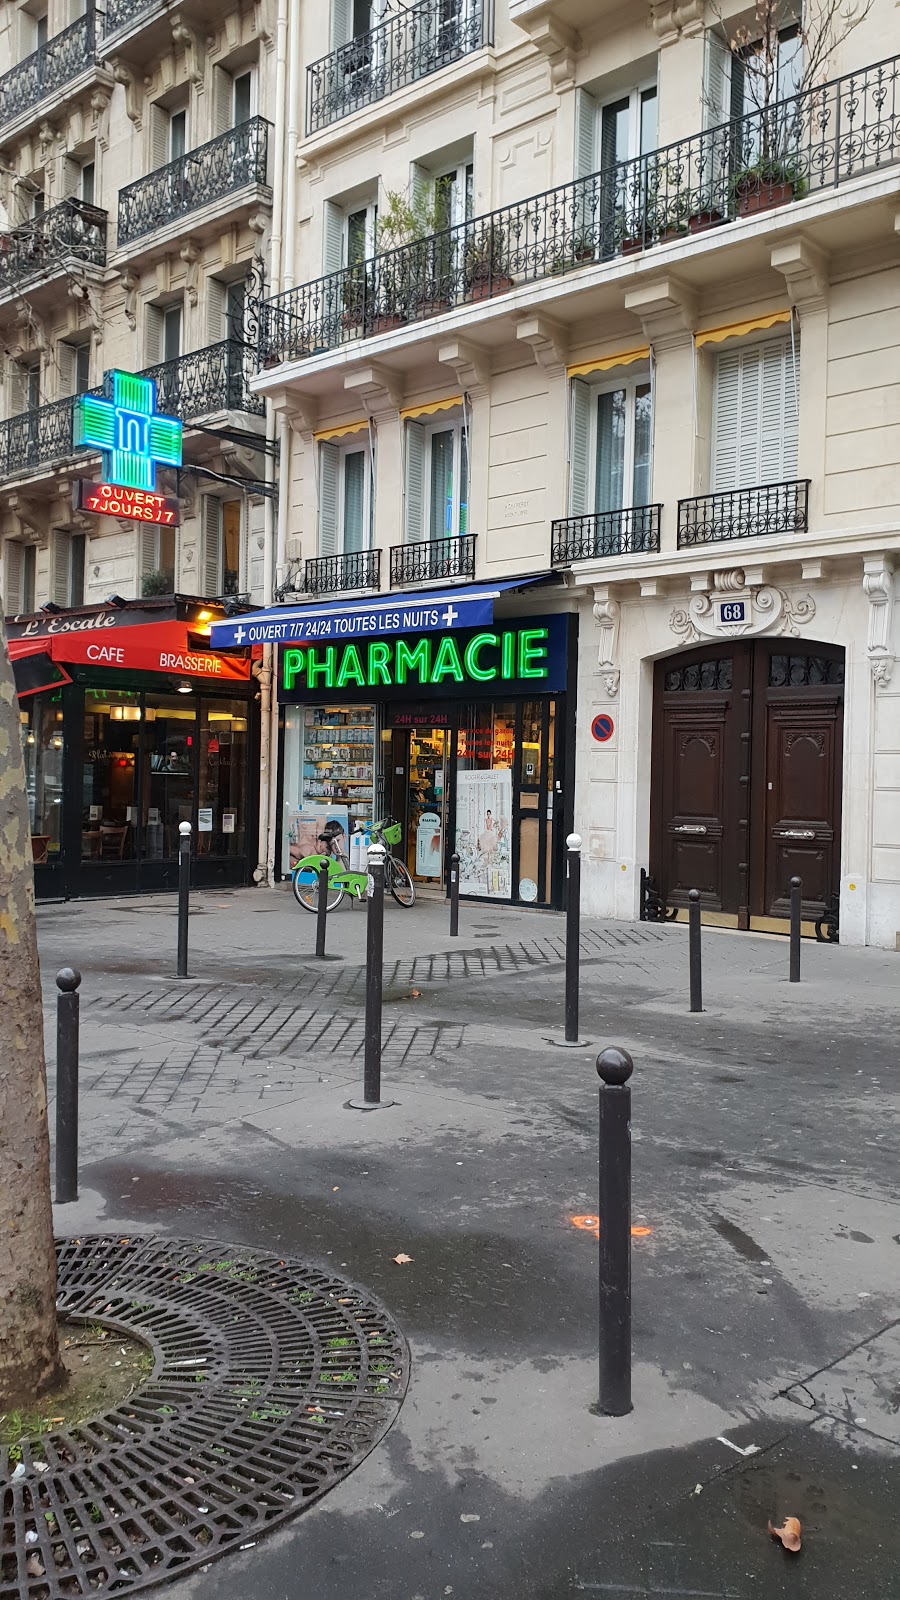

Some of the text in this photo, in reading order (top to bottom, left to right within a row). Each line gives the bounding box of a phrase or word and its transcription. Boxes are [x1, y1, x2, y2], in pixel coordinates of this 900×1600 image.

[101, 485, 164, 507] OUVERT
[724, 605, 741, 620] 68
[21, 611, 116, 637] L'Escale
[248, 610, 439, 641] OUVERT 7/7 24/24 TOUTES LES NUITS
[86, 645, 125, 663] CAFE
[159, 652, 222, 674] BRASSERIE
[283, 628, 548, 690] PHARMACIE
[394, 714, 448, 724] 24H sur 24H
[496, 739, 514, 747] nuits
[457, 749, 515, 759] 24H sur 24H
